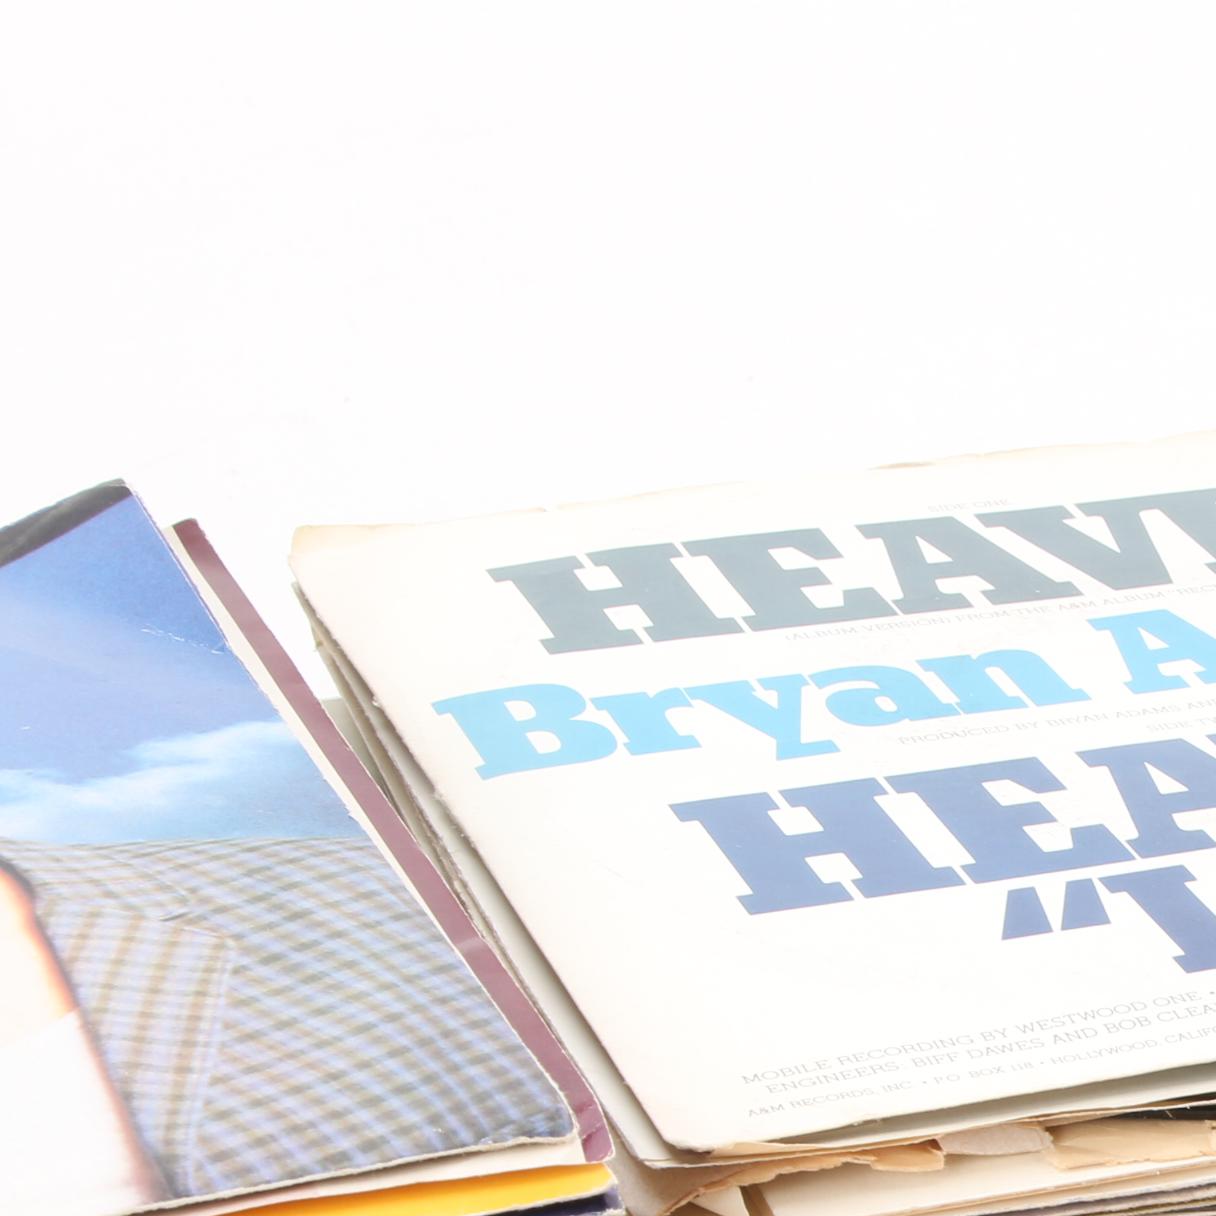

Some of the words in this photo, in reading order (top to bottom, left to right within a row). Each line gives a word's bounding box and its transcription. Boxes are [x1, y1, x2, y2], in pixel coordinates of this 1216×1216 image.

[955, 609, 1012, 622] FROM
[1012, 605, 1053, 616] THE
[1104, 591, 1166, 606] ALBUM
[430, 648, 1091, 782] Bryan
[898, 724, 1010, 745] PRODUCED
[1013, 720, 1039, 731] BY
[1045, 712, 1110, 728] BRYAN
[1113, 704, 1182, 719] ADAMS
[741, 1059, 832, 1085] MOBILE
[837, 1034, 975, 1066] RECORDING
[980, 1027, 1008, 1042] BY
[1016, 1001, 1148, 1034] WESTWOOD
[1152, 991, 1203, 1008] ONE
[911, 1051, 959, 1068] BIFF
[966, 1037, 1046, 1059] DAWES
[1053, 1027, 1099, 1045] AND
[1103, 1015, 1152, 1034] BOB
[749, 1103, 786, 1118] A&M
[968, 1065, 1006, 1079] BOX
